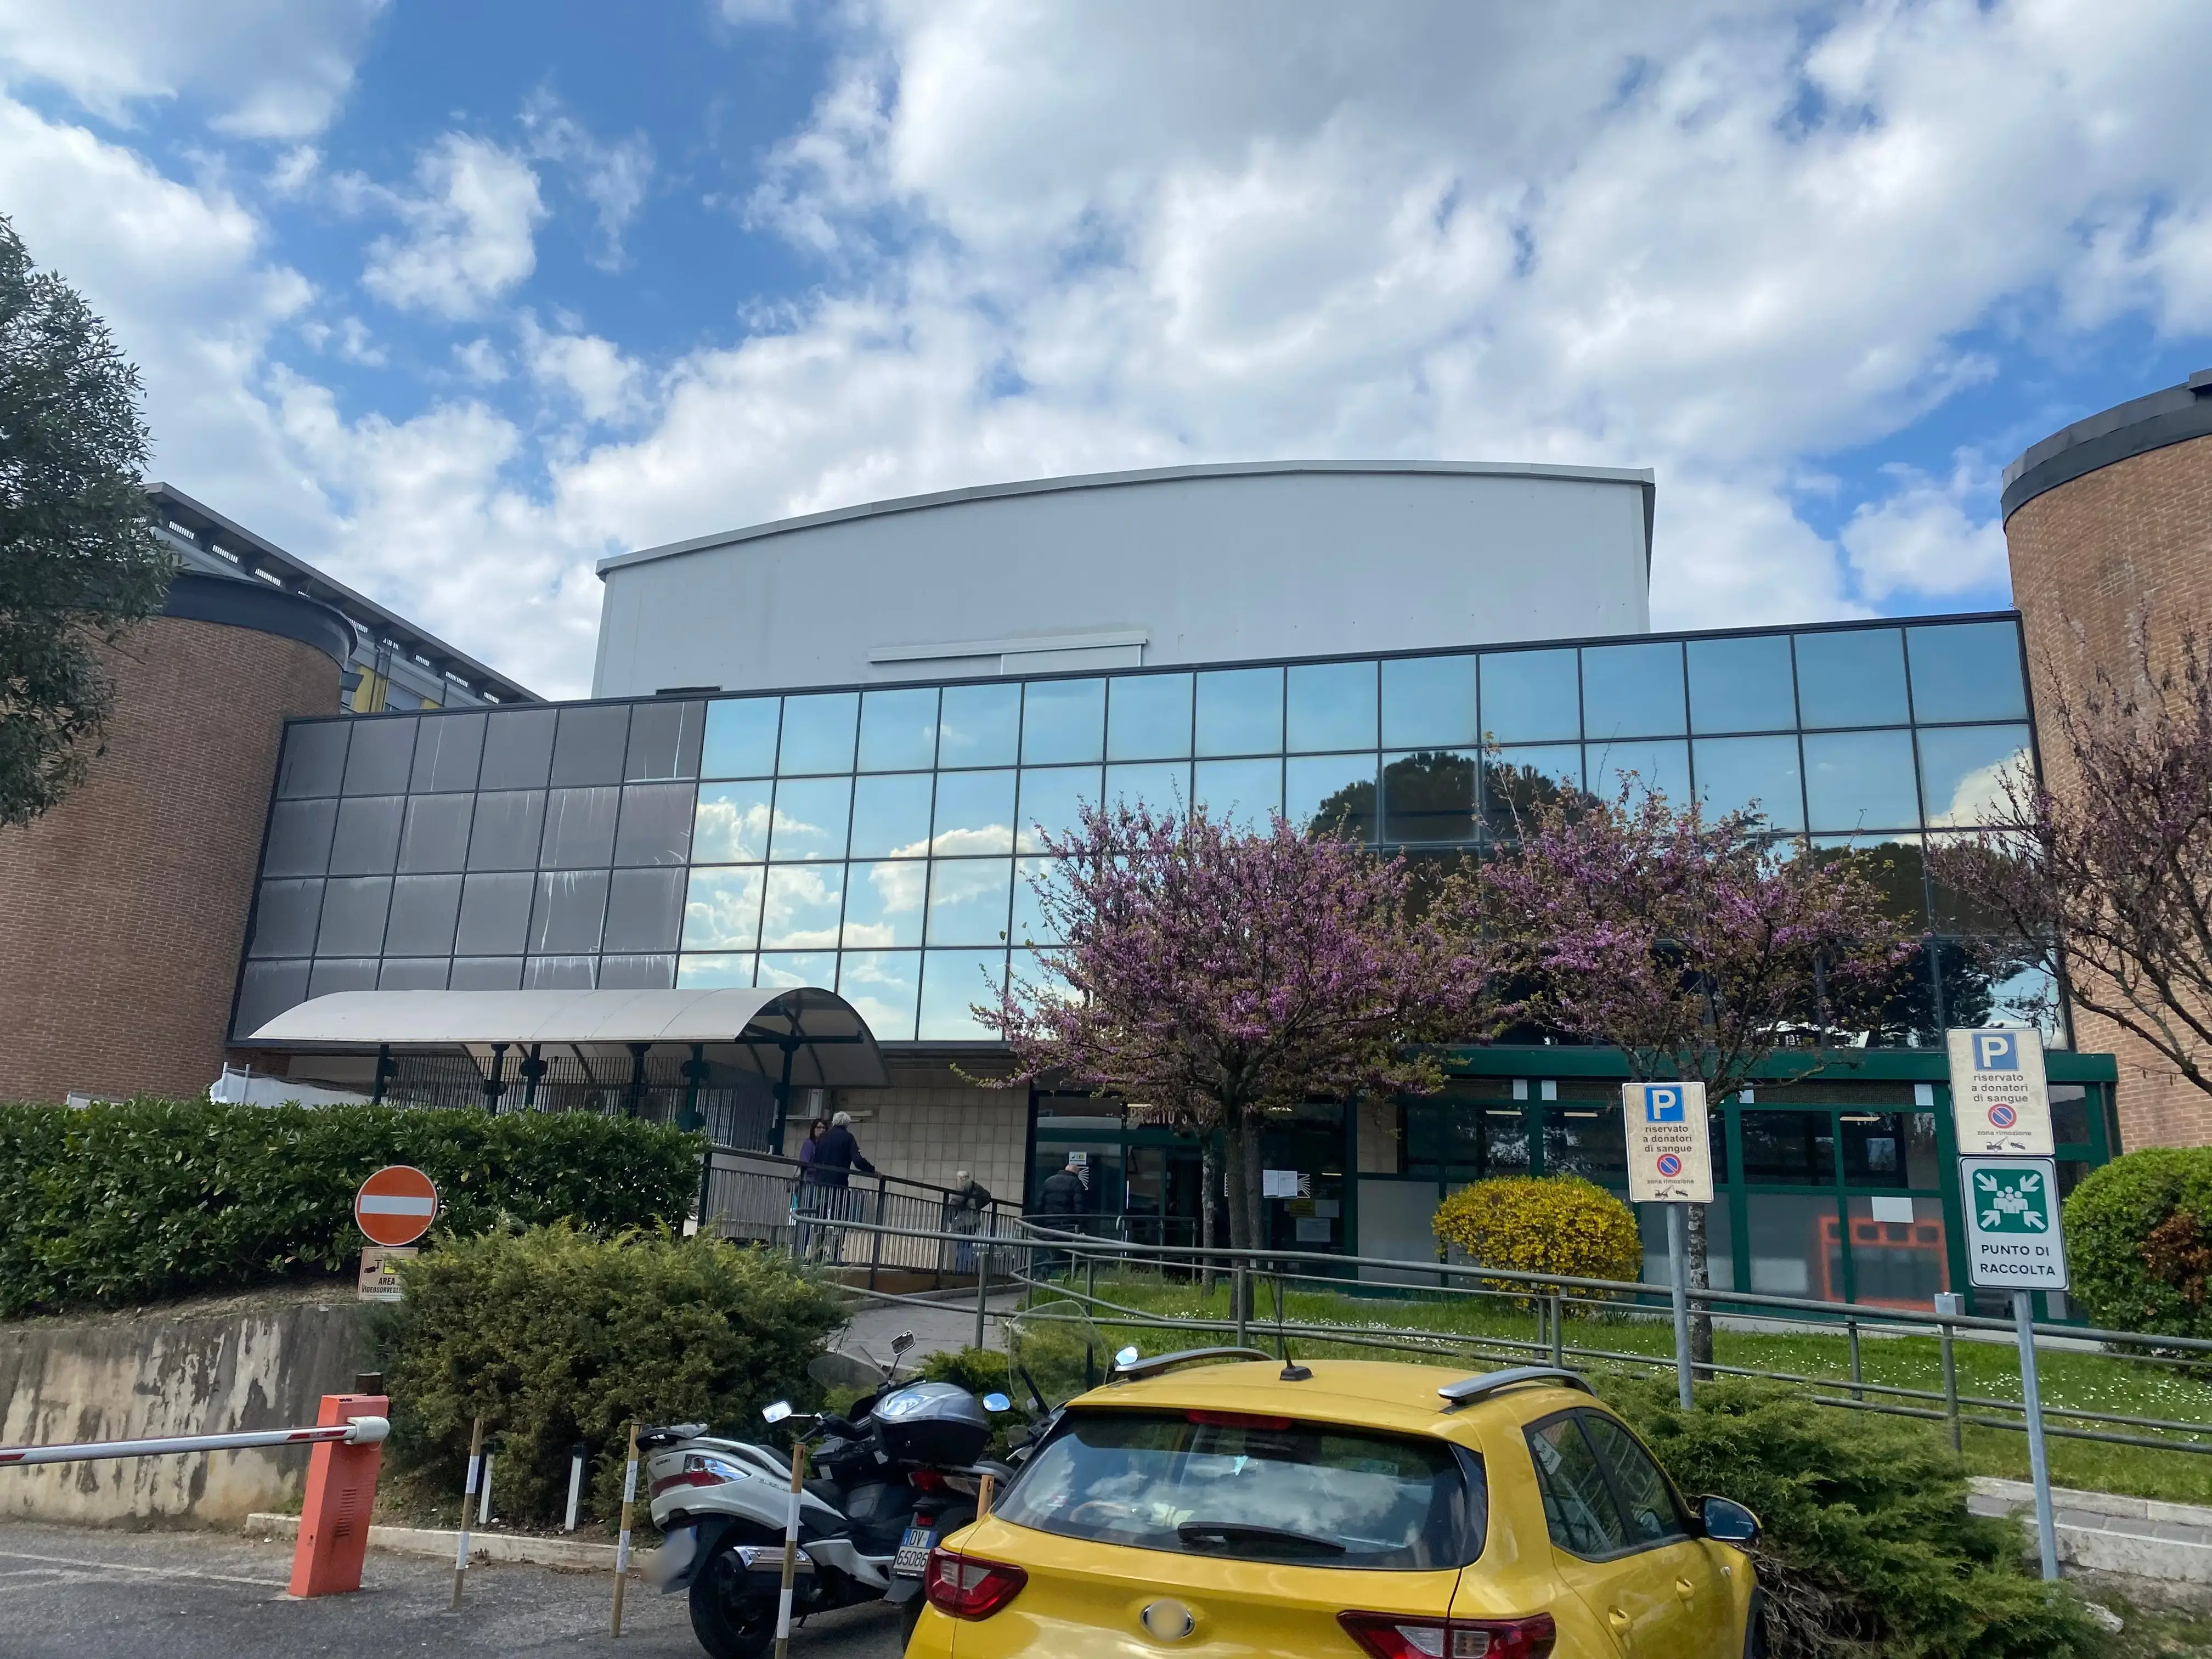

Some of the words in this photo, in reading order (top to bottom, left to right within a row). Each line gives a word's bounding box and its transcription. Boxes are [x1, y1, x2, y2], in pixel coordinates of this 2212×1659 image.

[1980, 1036, 2008, 1067] P
[1973, 1073, 2024, 1082] riservato
[1980, 1084, 2029, 1092] donatori
[1652, 1090, 1676, 1119] P
[1987, 1095, 2029, 1104] sangue
[1645, 1125, 1689, 1133] riservato
[1656, 1146, 1692, 1154] sangue
[1981, 1244, 2030, 1256] PUNTO
[2035, 1246, 2050, 1256] DI
[1980, 1263, 2056, 1276] RACCOLTA
[377, 1277, 396, 1285] AREA
[909, 1530, 925, 1547] DV
[896, 1550, 929, 1567] 65086
